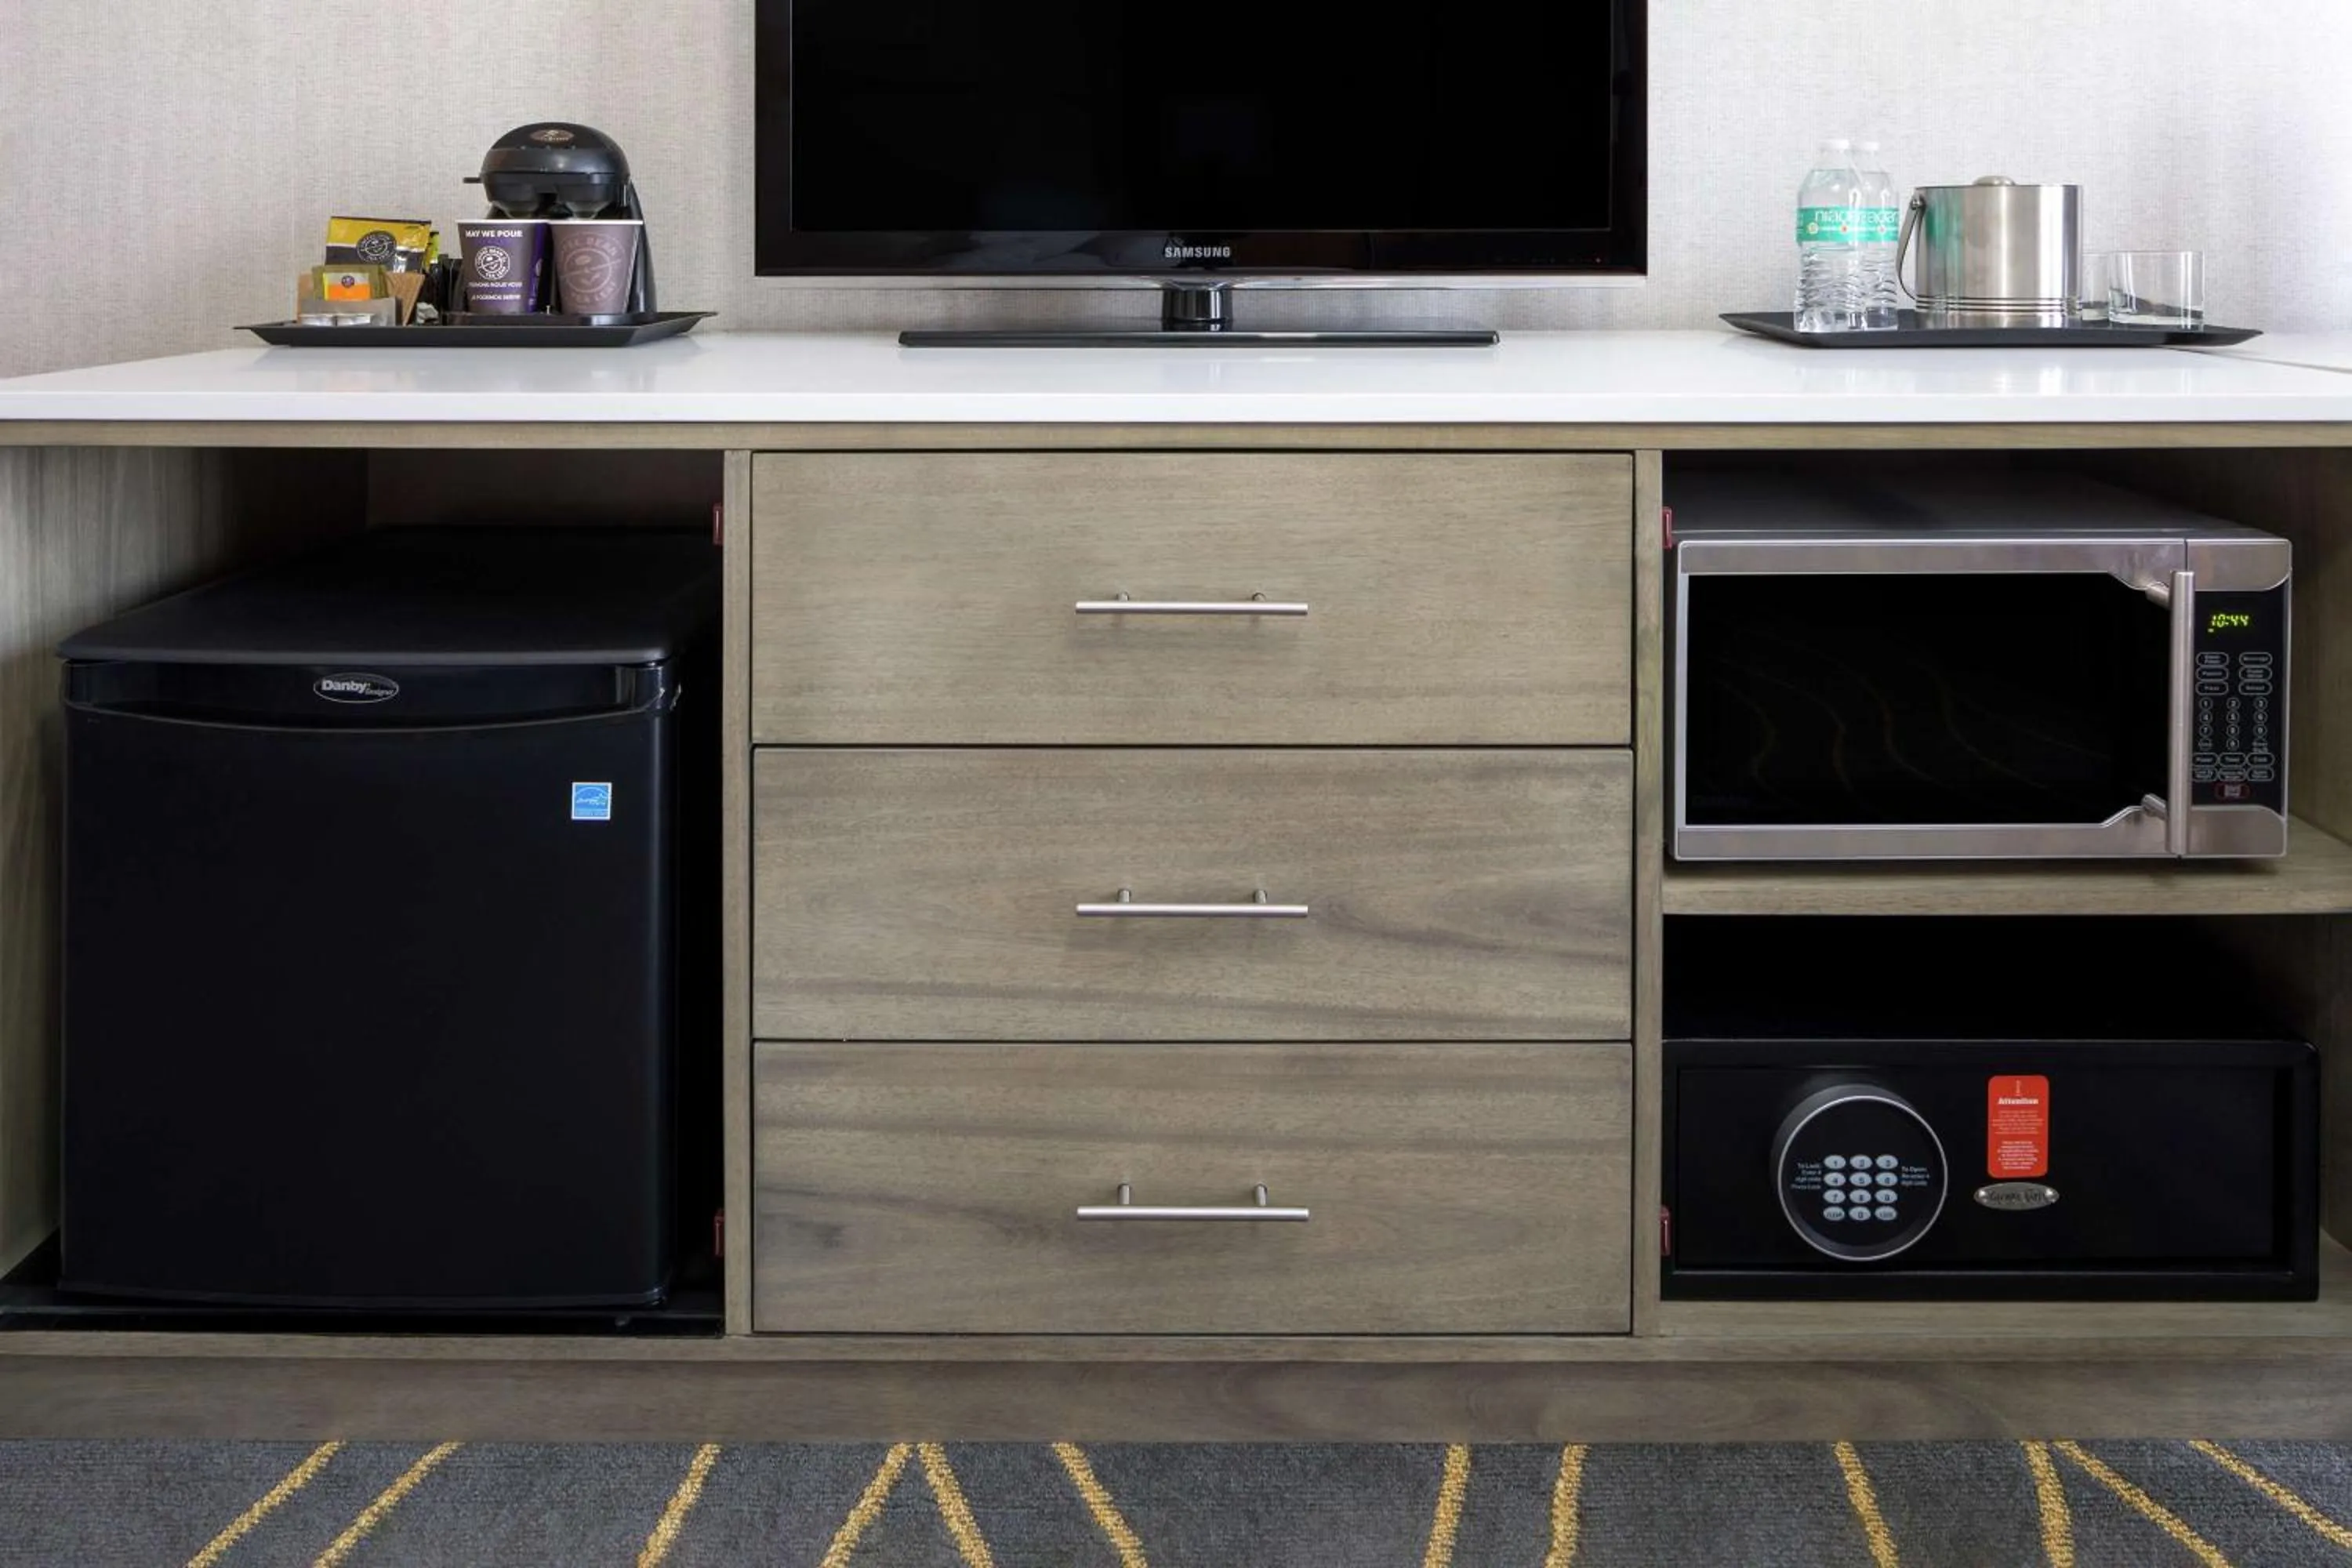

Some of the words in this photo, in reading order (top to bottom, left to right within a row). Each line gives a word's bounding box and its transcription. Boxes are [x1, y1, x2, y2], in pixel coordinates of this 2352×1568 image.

[1165, 247, 1230, 258] SAMSUNG
[2212, 615, 2249, 627] 10:44
[321, 680, 367, 694] Danby
